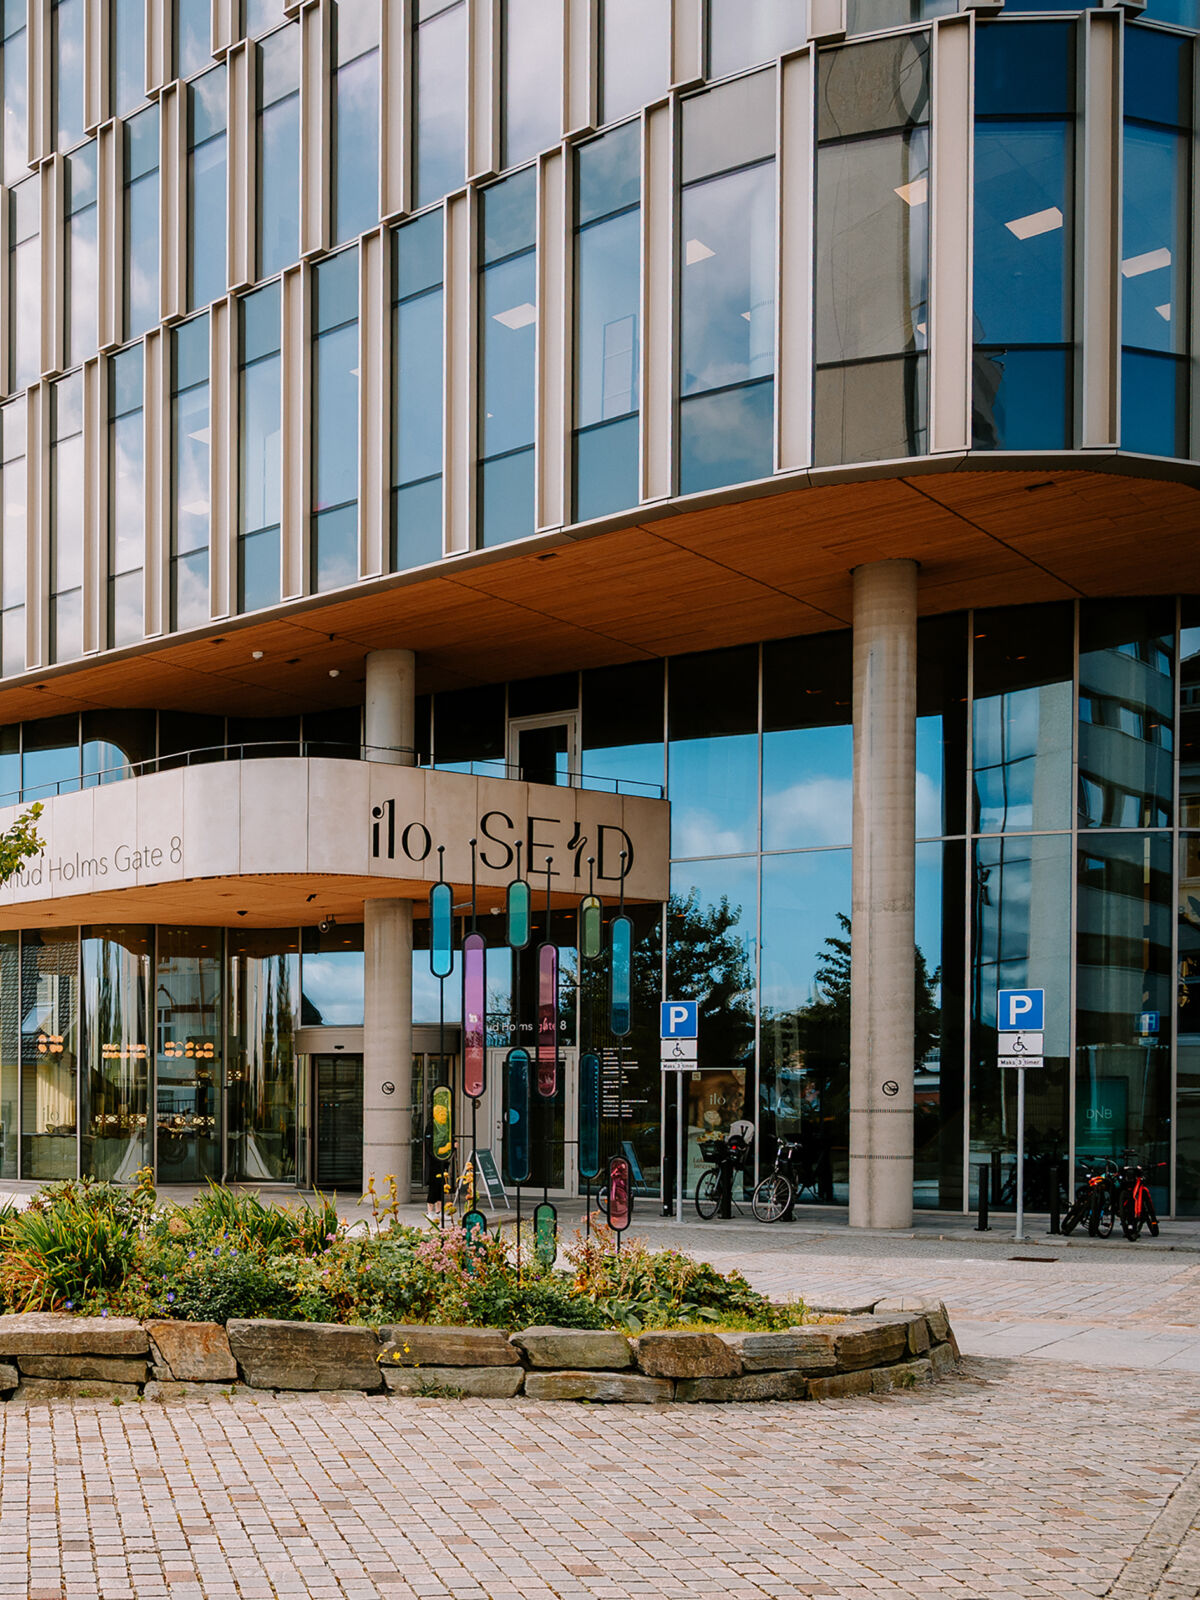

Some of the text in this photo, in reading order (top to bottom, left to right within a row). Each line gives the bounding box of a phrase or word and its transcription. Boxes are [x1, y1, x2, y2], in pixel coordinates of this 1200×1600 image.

[372, 799, 432, 862] ilo
[49, 852, 108, 882] Holms
[114, 844, 162, 872] Gate
[169, 835, 183, 864] 8
[669, 1006, 688, 1033] P
[1009, 995, 1032, 1025] P
[502, 1022, 533, 1031] Homs
[560, 1020, 567, 1031] 8
[709, 1092, 726, 1105] ilo
[1086, 1105, 1113, 1123] DNB
